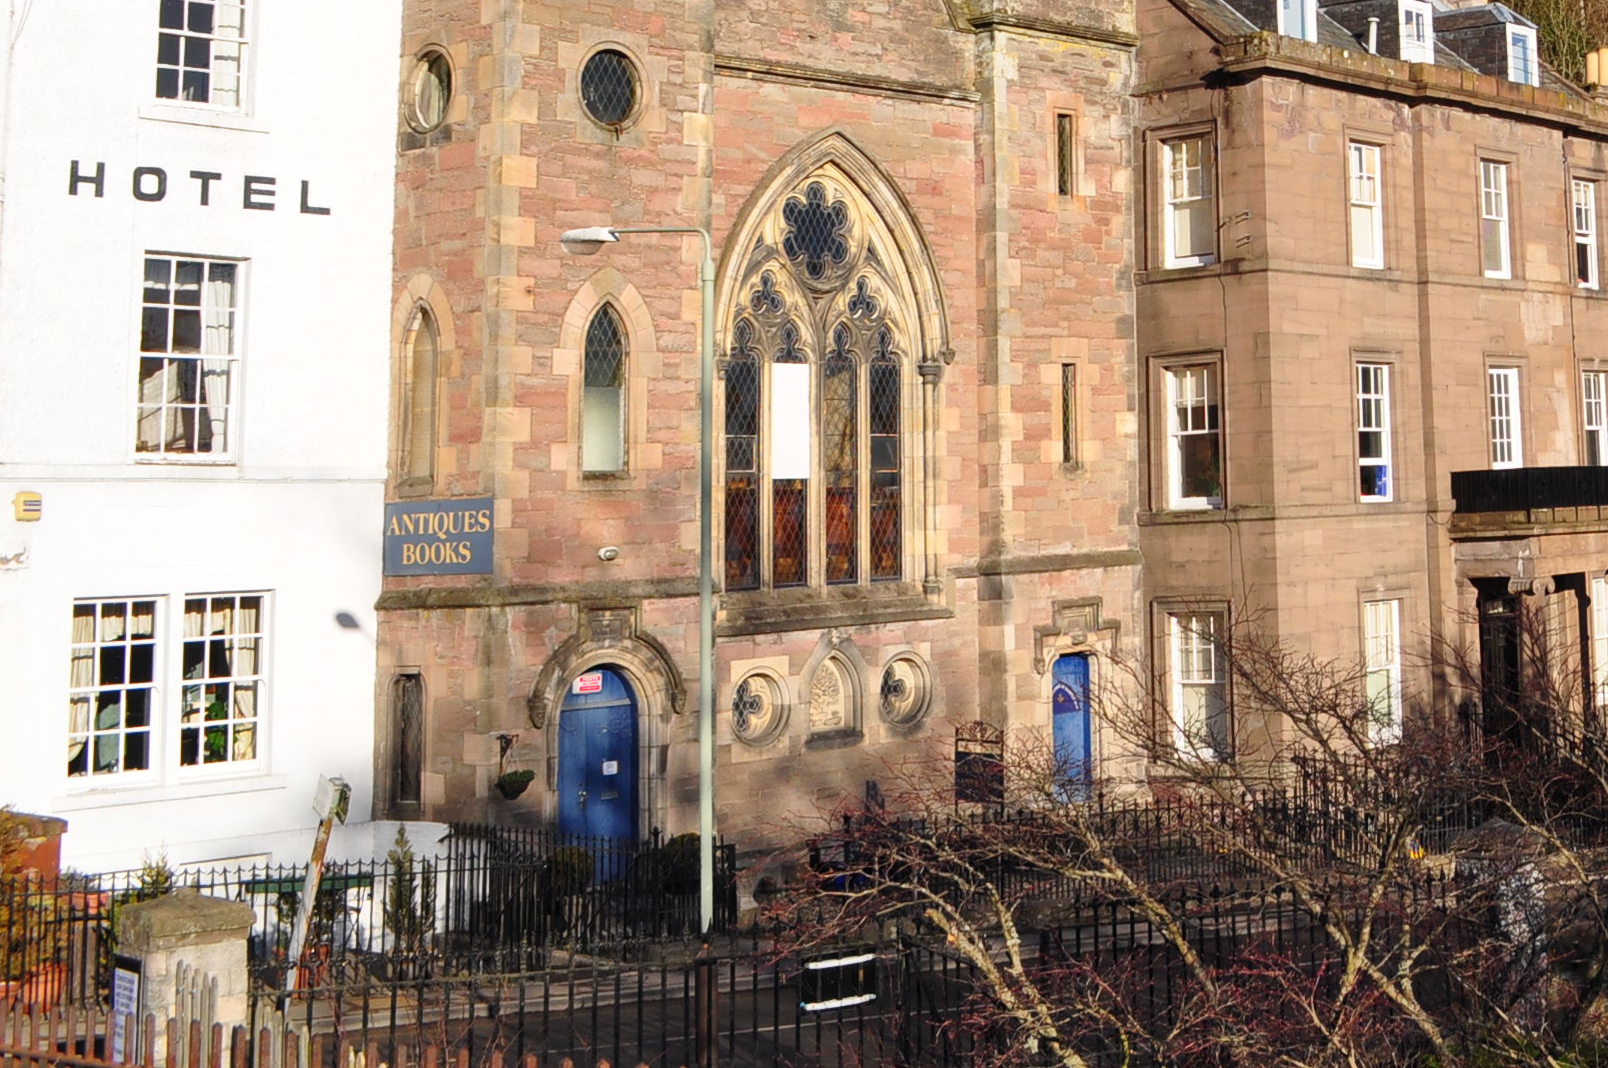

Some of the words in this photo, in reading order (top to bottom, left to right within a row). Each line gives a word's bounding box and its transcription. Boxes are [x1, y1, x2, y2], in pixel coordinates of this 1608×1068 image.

[68, 160, 331, 215] HOTEL
[387, 509, 491, 539] ANTIQUES
[402, 541, 472, 564] BOOKS
